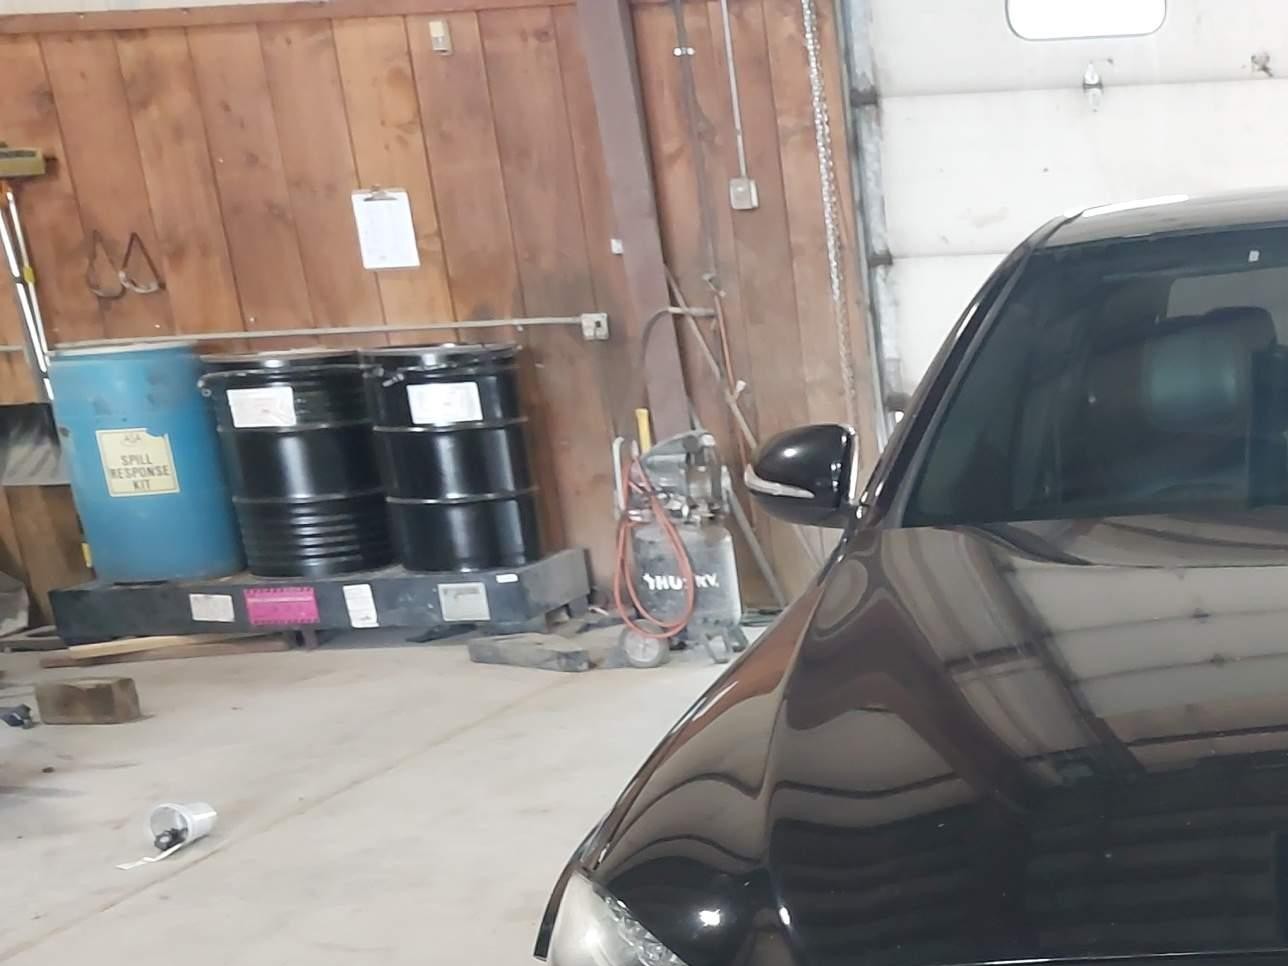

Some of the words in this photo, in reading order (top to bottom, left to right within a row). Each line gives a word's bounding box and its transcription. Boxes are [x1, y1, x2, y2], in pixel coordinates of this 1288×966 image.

[120, 454, 153, 466] SPILL
[109, 465, 170, 480] RESPONSE
[132, 480, 151, 490] KIT
